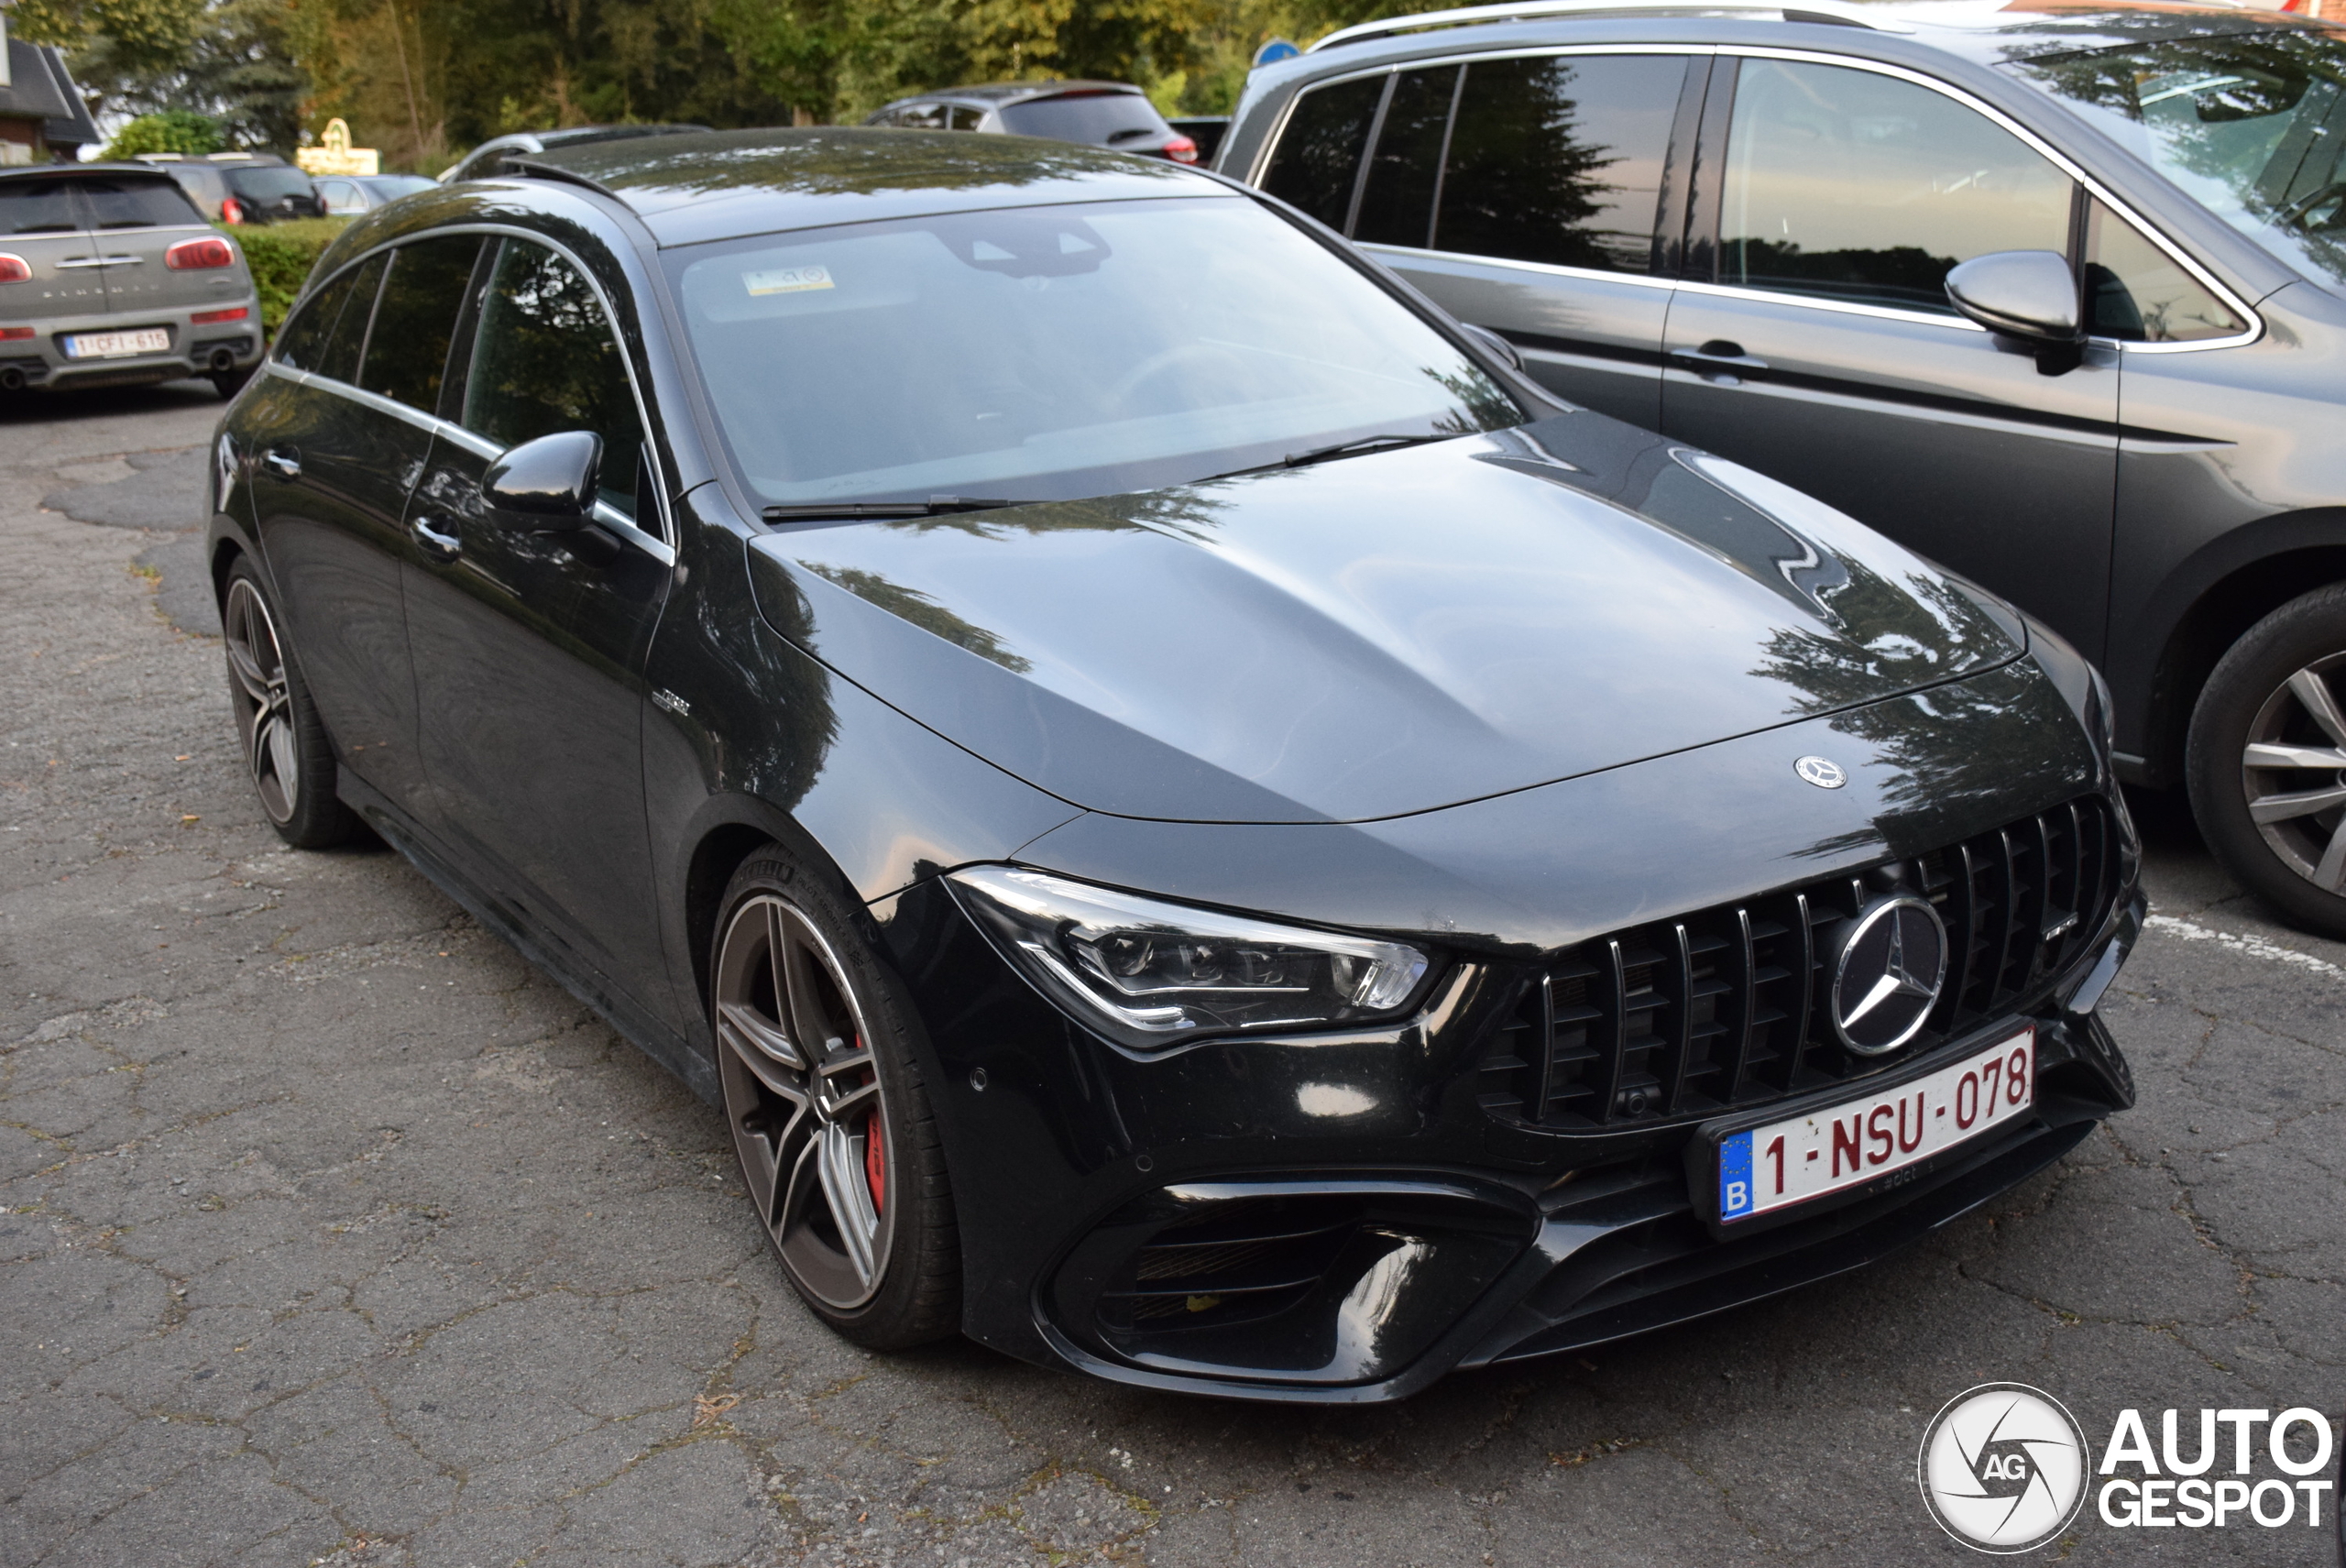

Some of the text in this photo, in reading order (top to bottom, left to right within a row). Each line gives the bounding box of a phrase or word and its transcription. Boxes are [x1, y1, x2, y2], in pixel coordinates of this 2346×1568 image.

[797, 877, 817, 898] PILOT
[1766, 1047, 2027, 1195] 1-NSU-078
[1727, 1181, 1748, 1211] B
